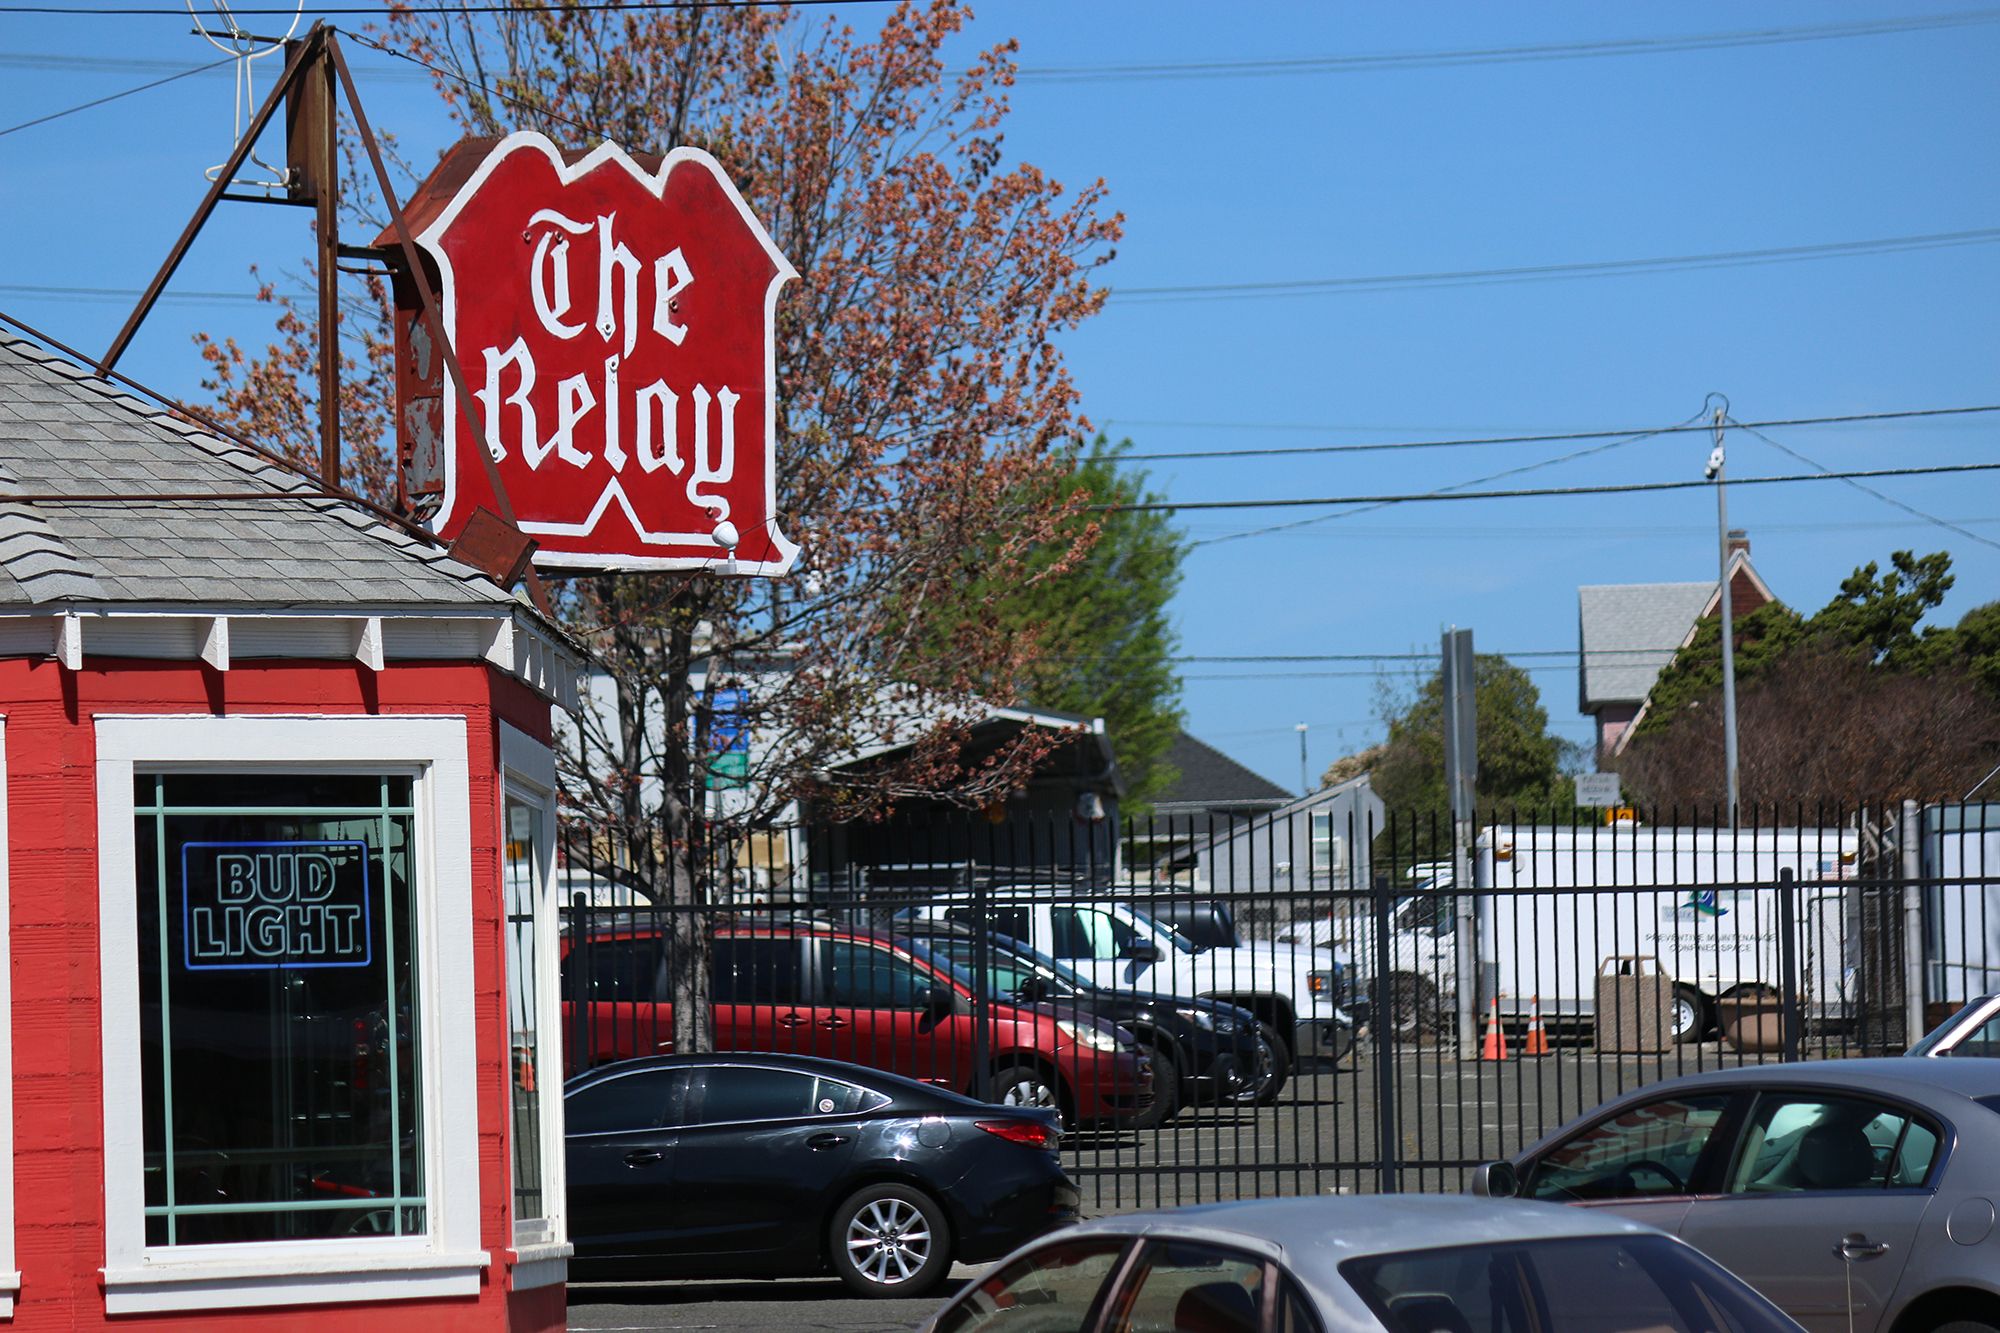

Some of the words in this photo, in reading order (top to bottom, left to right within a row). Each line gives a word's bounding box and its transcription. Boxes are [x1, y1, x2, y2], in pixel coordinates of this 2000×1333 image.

[528, 208, 694, 359] The
[473, 335, 740, 522] Relay
[216, 853, 336, 904] BUD
[193, 905, 361, 956] LIGHT
[1669, 943, 1718, 953] CONFNED
[1707, 933, 1777, 942] MINTENACE
